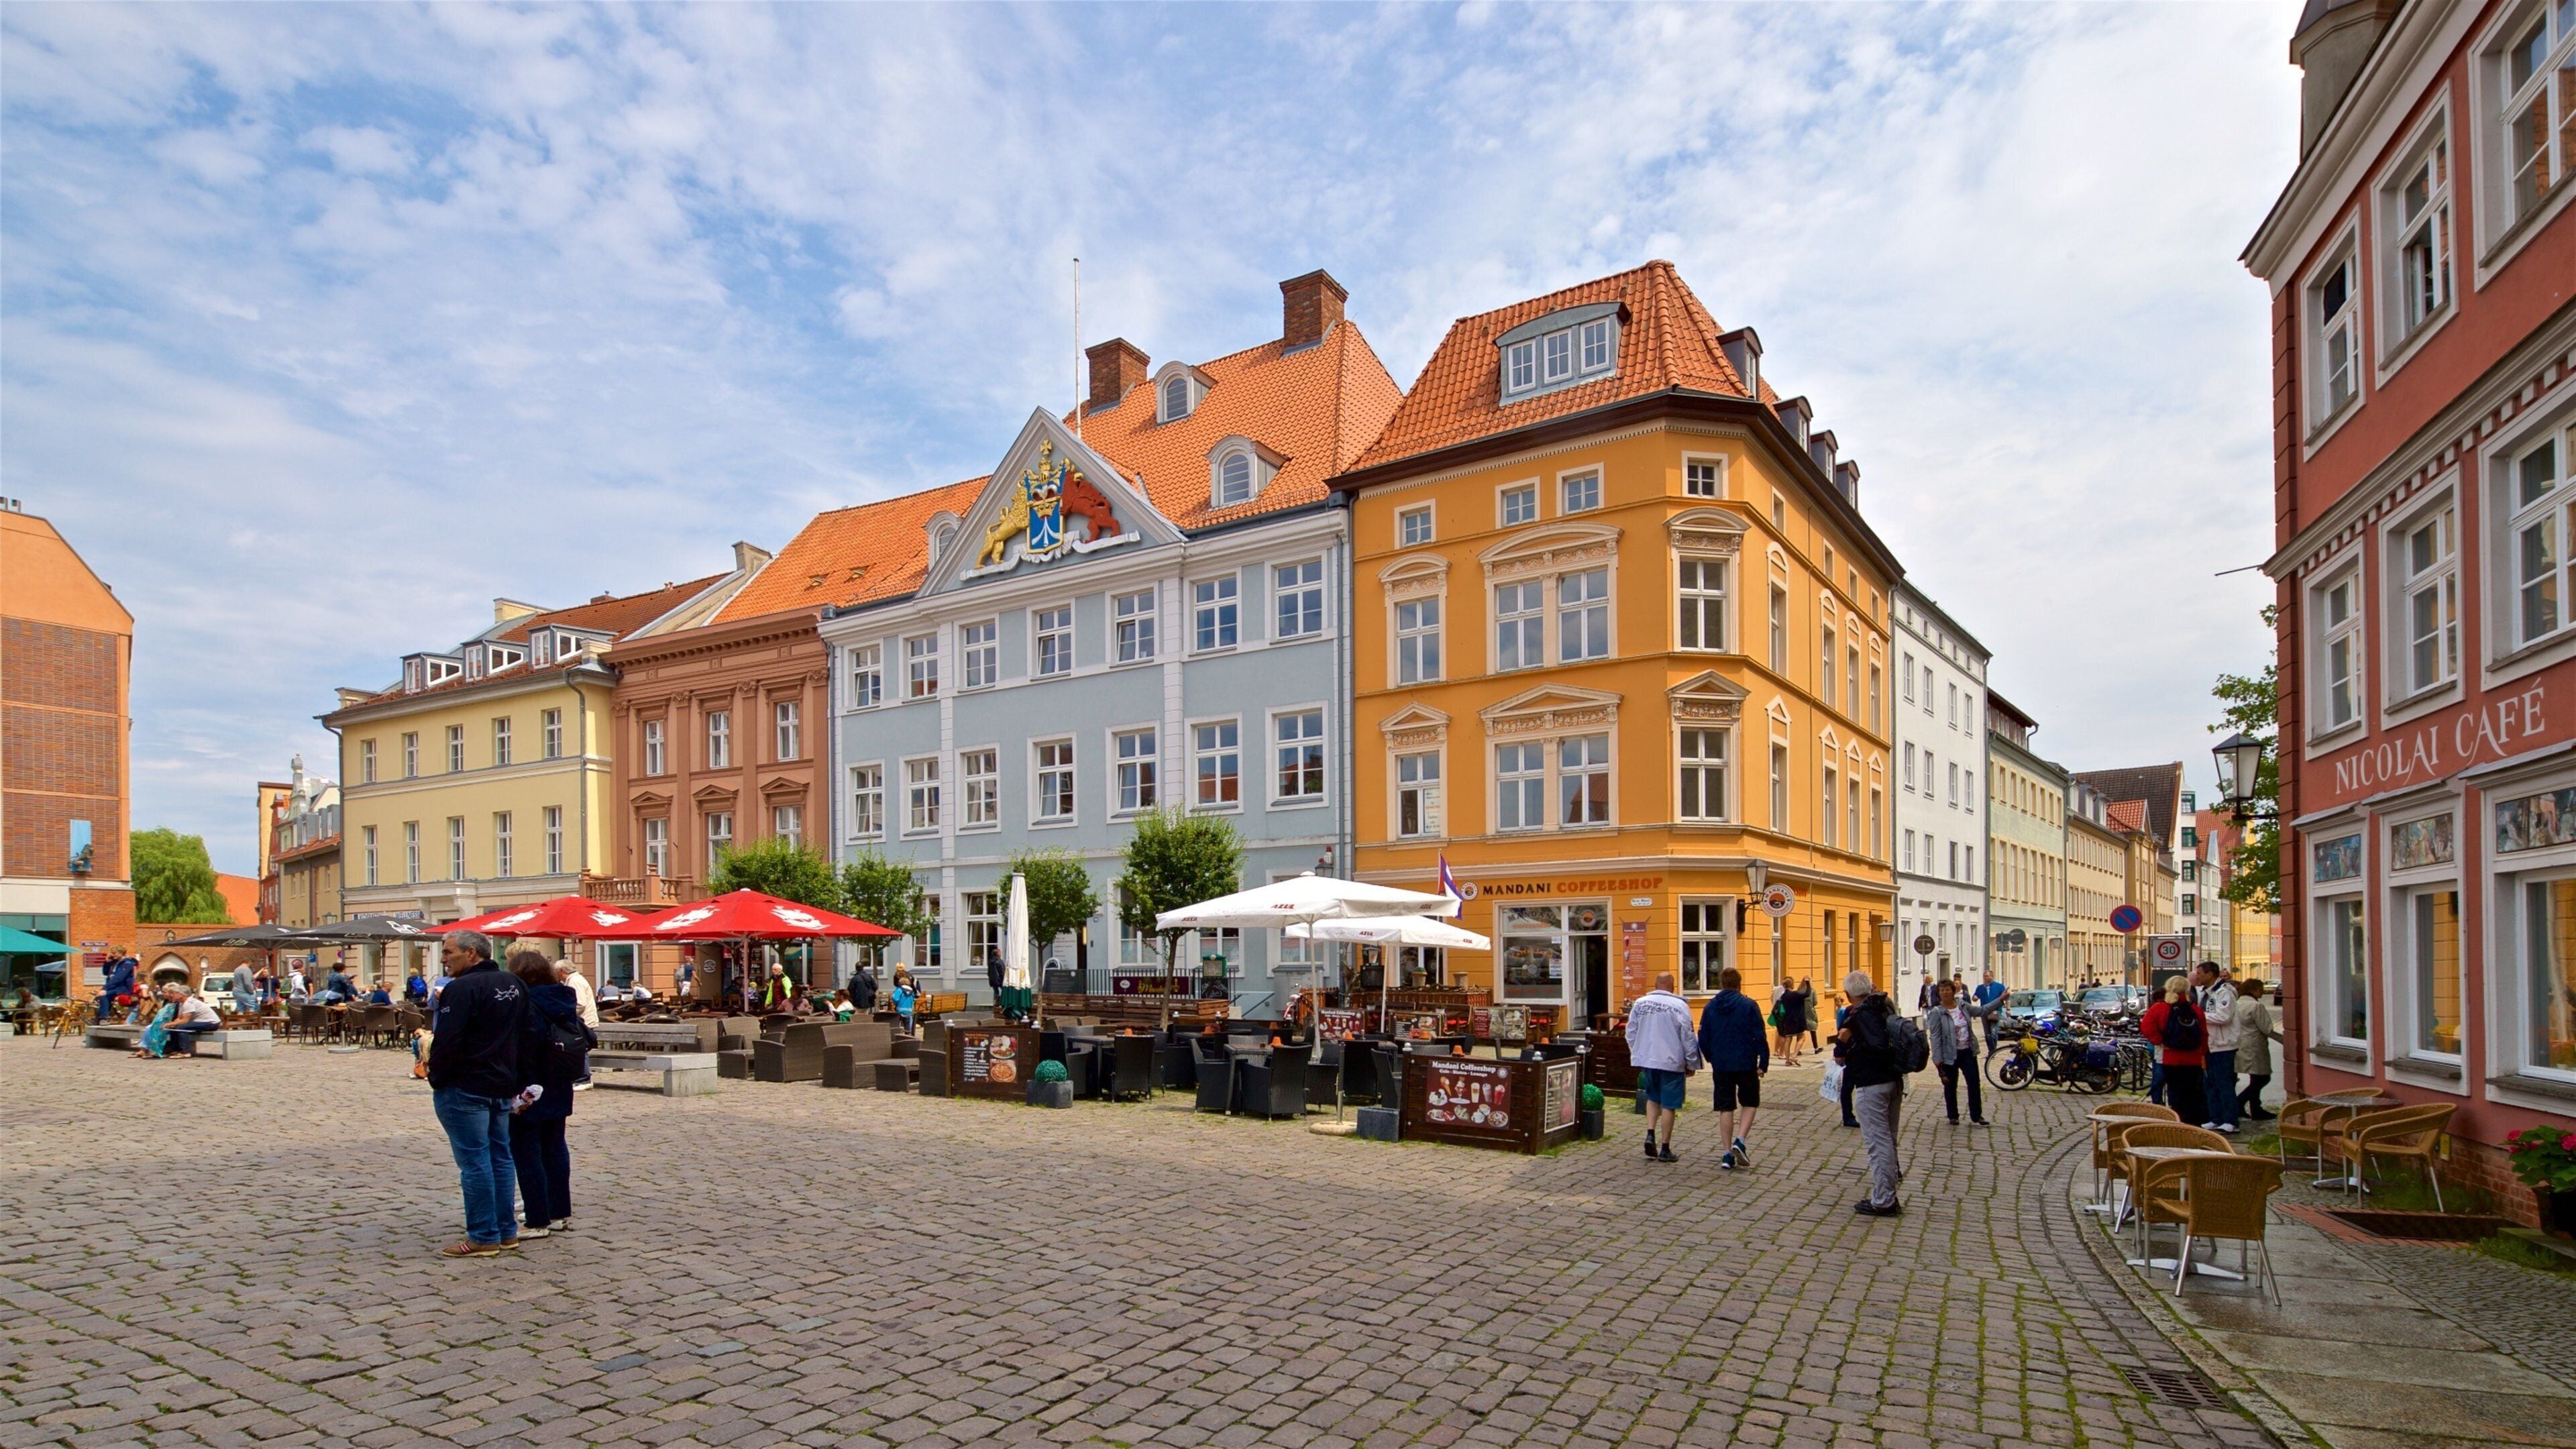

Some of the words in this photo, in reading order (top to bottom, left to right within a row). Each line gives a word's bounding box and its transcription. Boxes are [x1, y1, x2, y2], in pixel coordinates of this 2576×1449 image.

[2335, 725, 2439, 794] NICOLAI
[2455, 676, 2546, 766] CAFÉ
[1483, 883, 1551, 896] MANDANI
[1556, 877, 1663, 893] COFFEESHOP
[2162, 946, 2176, 954] 30
[1460, 1063, 1496, 1073] Coffeeshop
